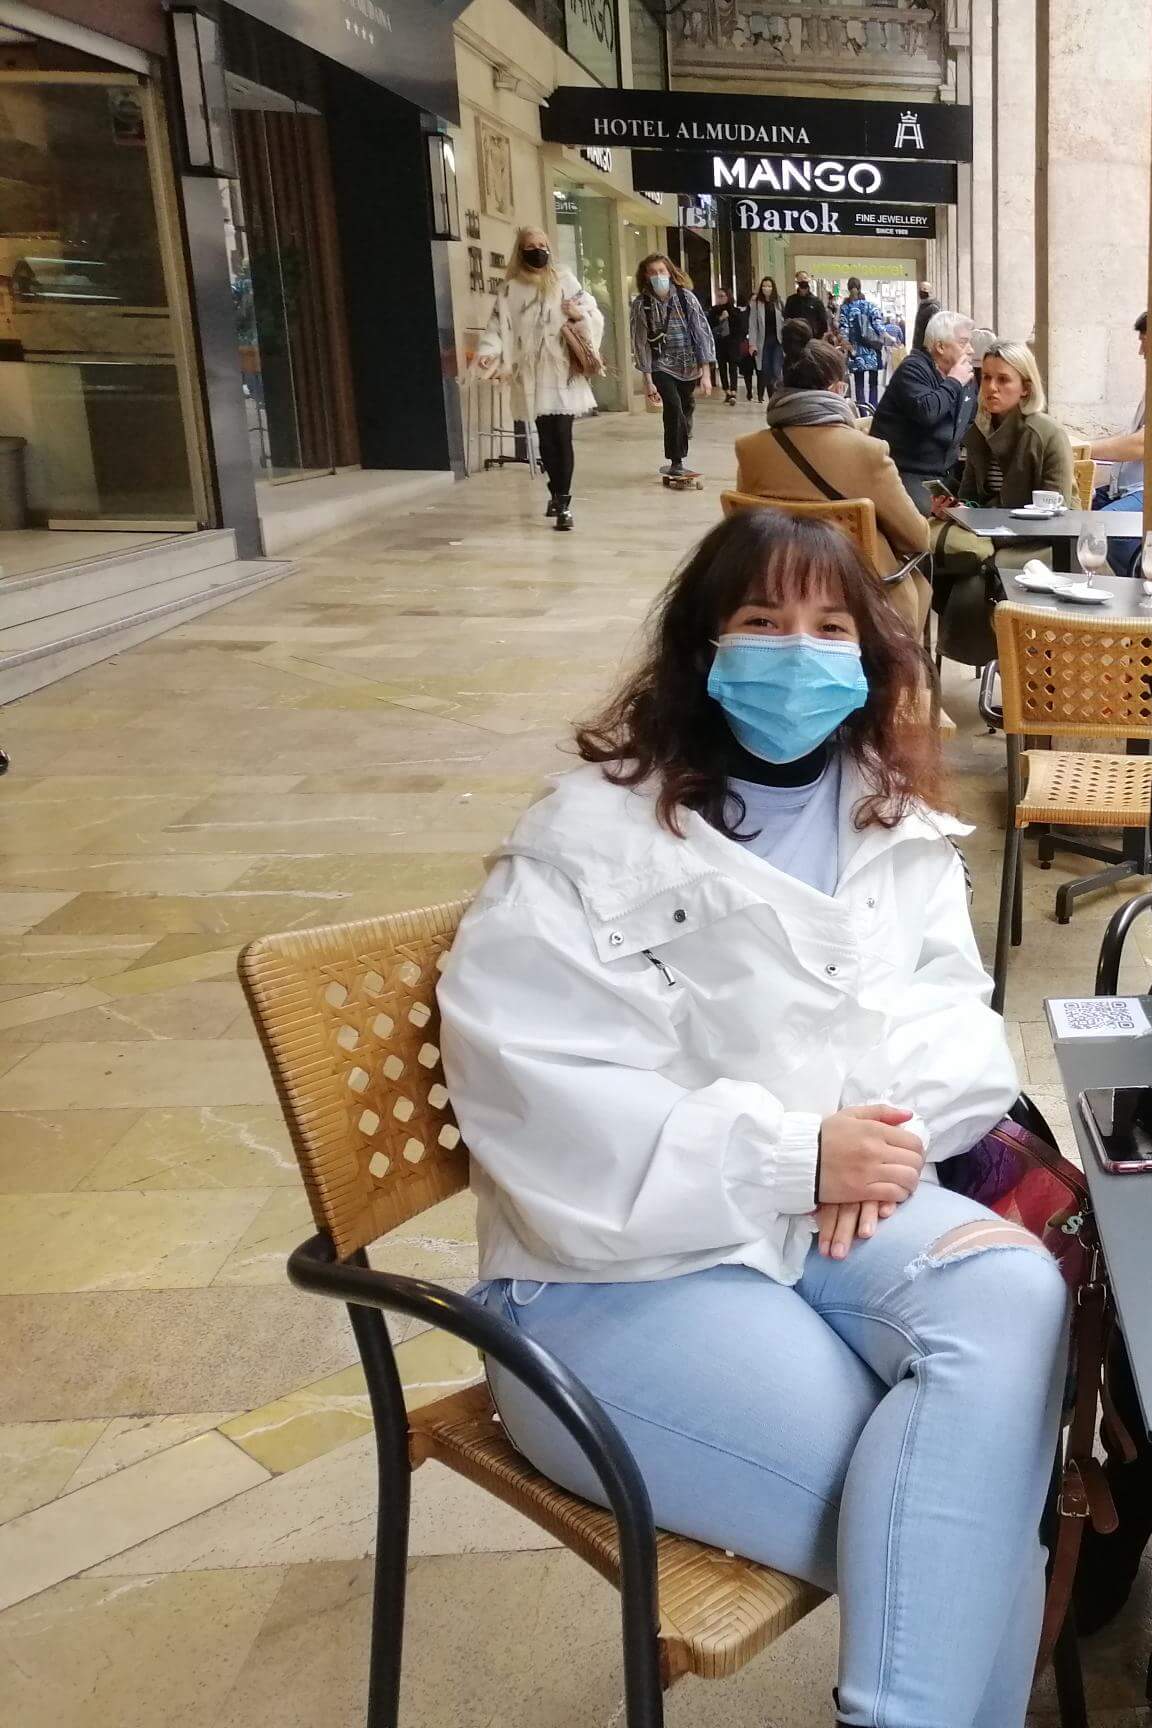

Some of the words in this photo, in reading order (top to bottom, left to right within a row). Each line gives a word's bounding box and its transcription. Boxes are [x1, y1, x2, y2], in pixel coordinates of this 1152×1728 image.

[594, 118, 670, 138] HOTEL
[676, 121, 810, 144] ALMUDAINA
[713, 156, 882, 194] MANGO
[736, 200, 841, 233] Barok
[855, 213, 876, 223] FINE
[878, 214, 928, 225] JEWELLERY
